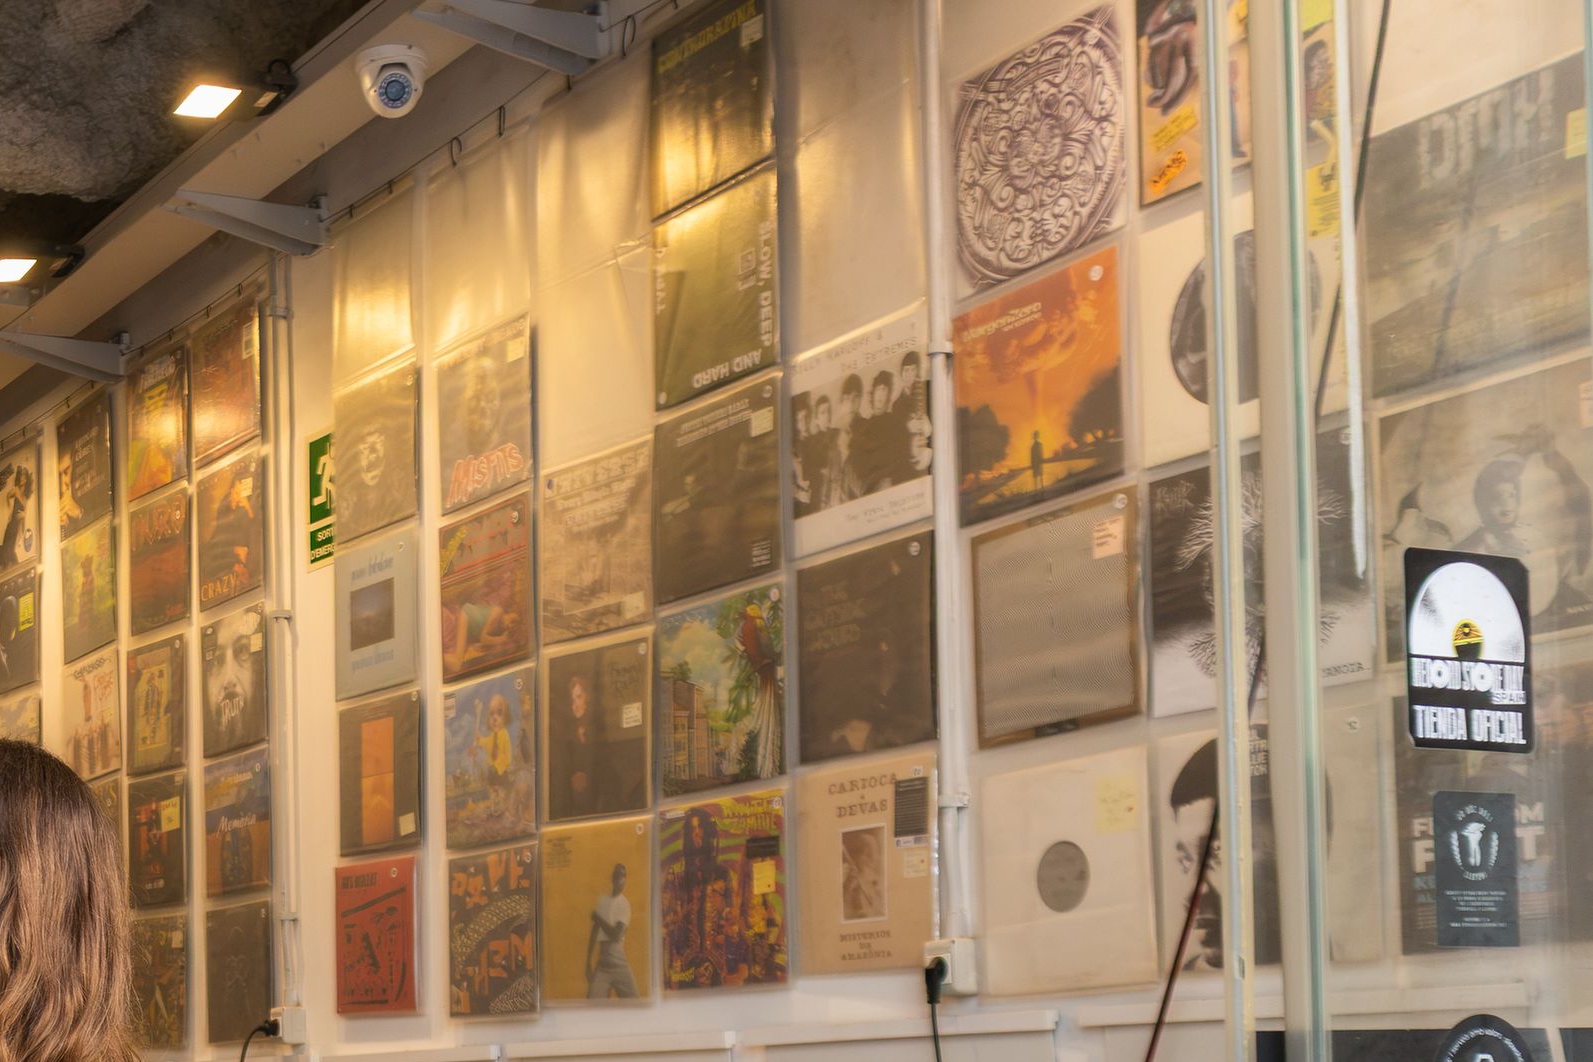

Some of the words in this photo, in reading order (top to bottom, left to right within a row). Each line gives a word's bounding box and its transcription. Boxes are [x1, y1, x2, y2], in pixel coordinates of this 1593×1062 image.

[760, 290, 773, 346] DEEP
[692, 362, 730, 388] HARD
[734, 349, 763, 375] AND
[317, 527, 334, 542] SORT
[837, 800, 888, 818] DEVAS
